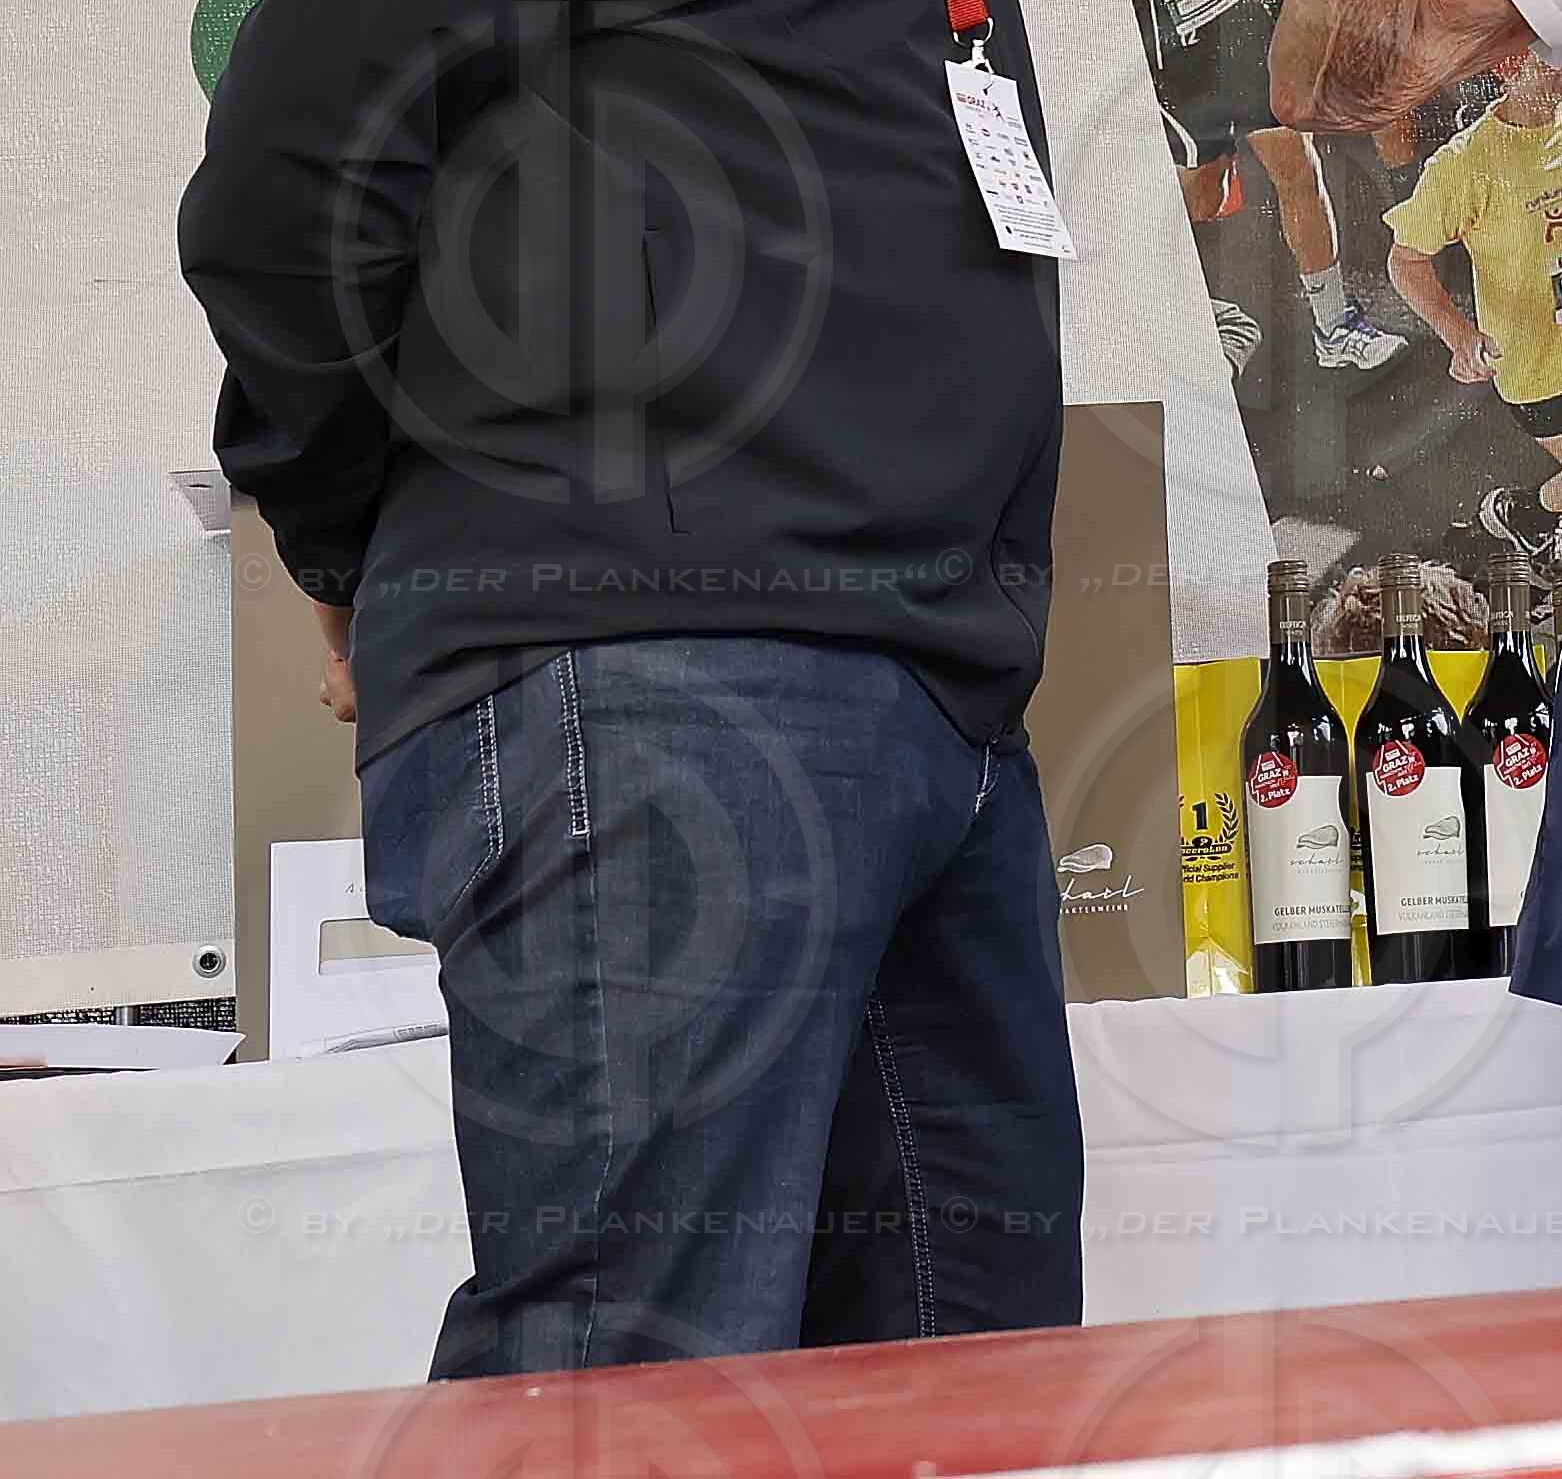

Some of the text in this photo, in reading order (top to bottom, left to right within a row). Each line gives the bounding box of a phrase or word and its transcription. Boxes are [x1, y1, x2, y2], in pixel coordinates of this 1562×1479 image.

[1382, 755, 1409, 772] GRAZ
[1505, 749, 1531, 767] GRAZ
[1258, 768, 1282, 782] GRAZ
[1522, 765, 1543, 780] Platz
[1397, 774, 1420, 788] Platz
[1269, 787, 1291, 799] Platz
[1203, 862, 1235, 873] Supplier
[1195, 871, 1239, 883] Champions
[1400, 897, 1434, 907] GELBER
[1274, 906, 1307, 917] GELBER
